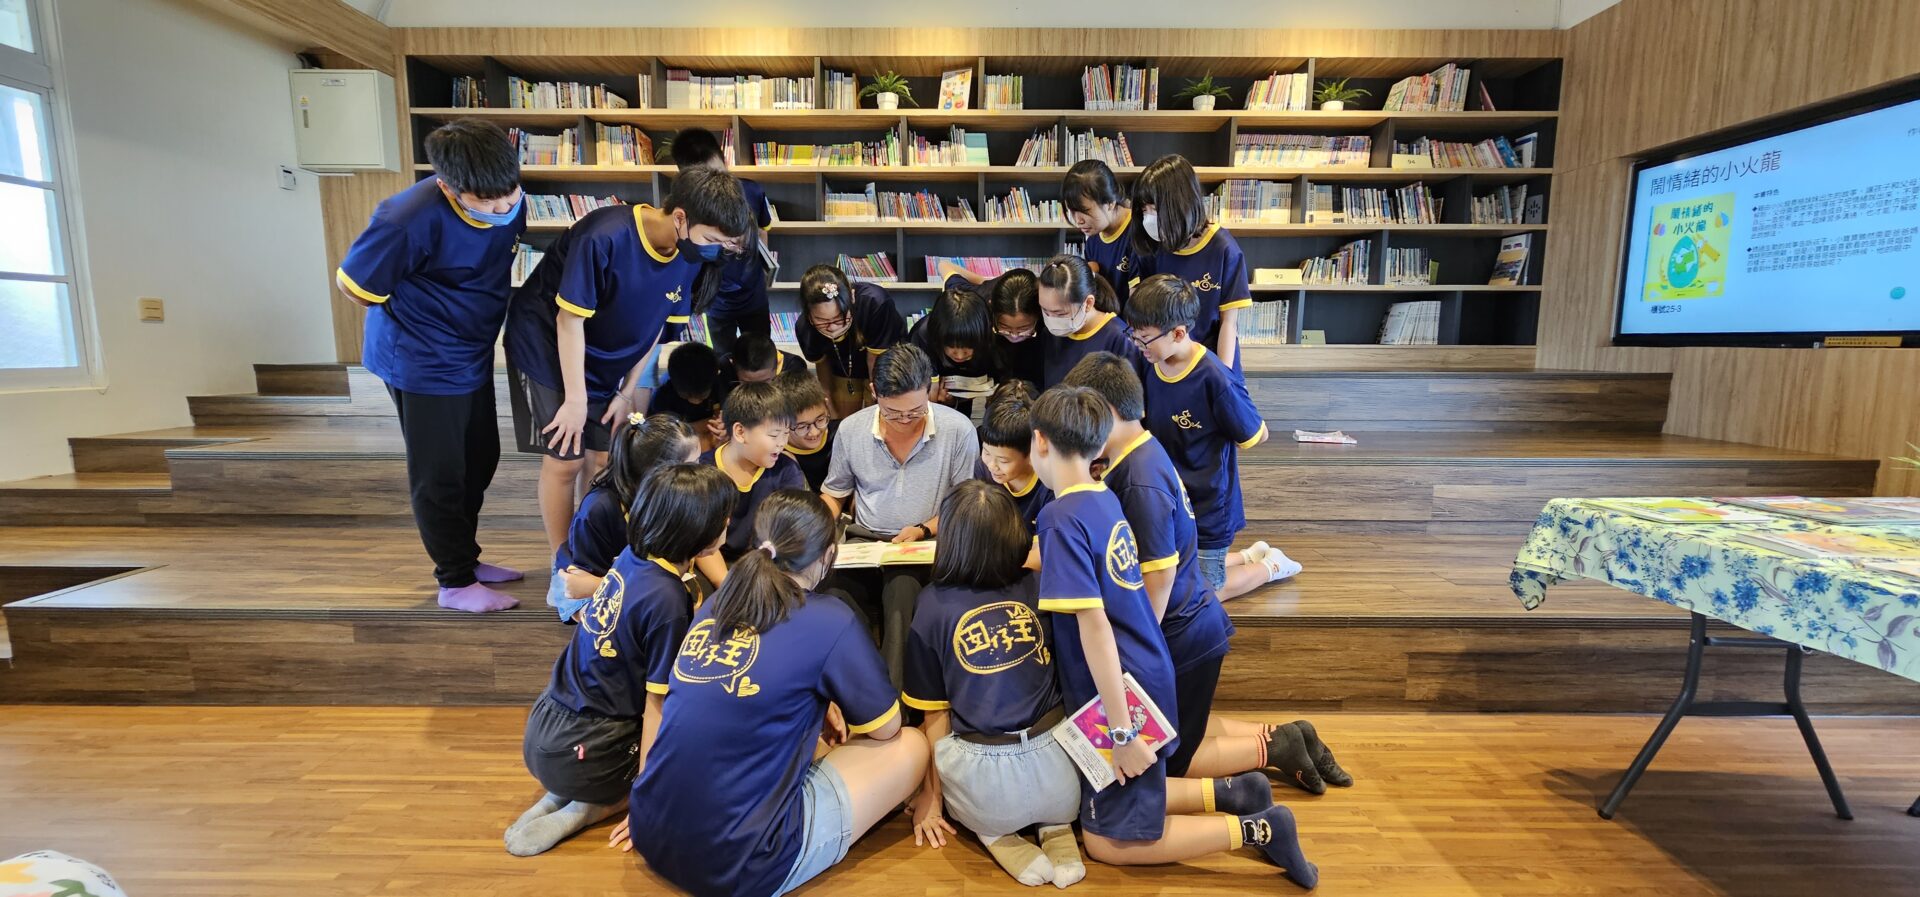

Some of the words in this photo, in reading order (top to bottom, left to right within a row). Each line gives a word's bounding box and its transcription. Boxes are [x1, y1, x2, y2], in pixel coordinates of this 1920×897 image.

[1650, 149, 1782, 197] 鬧情緒的小火龍
[1670, 202, 1713, 219] 鬧情緒的
[1672, 219, 1707, 235] 小火龍
